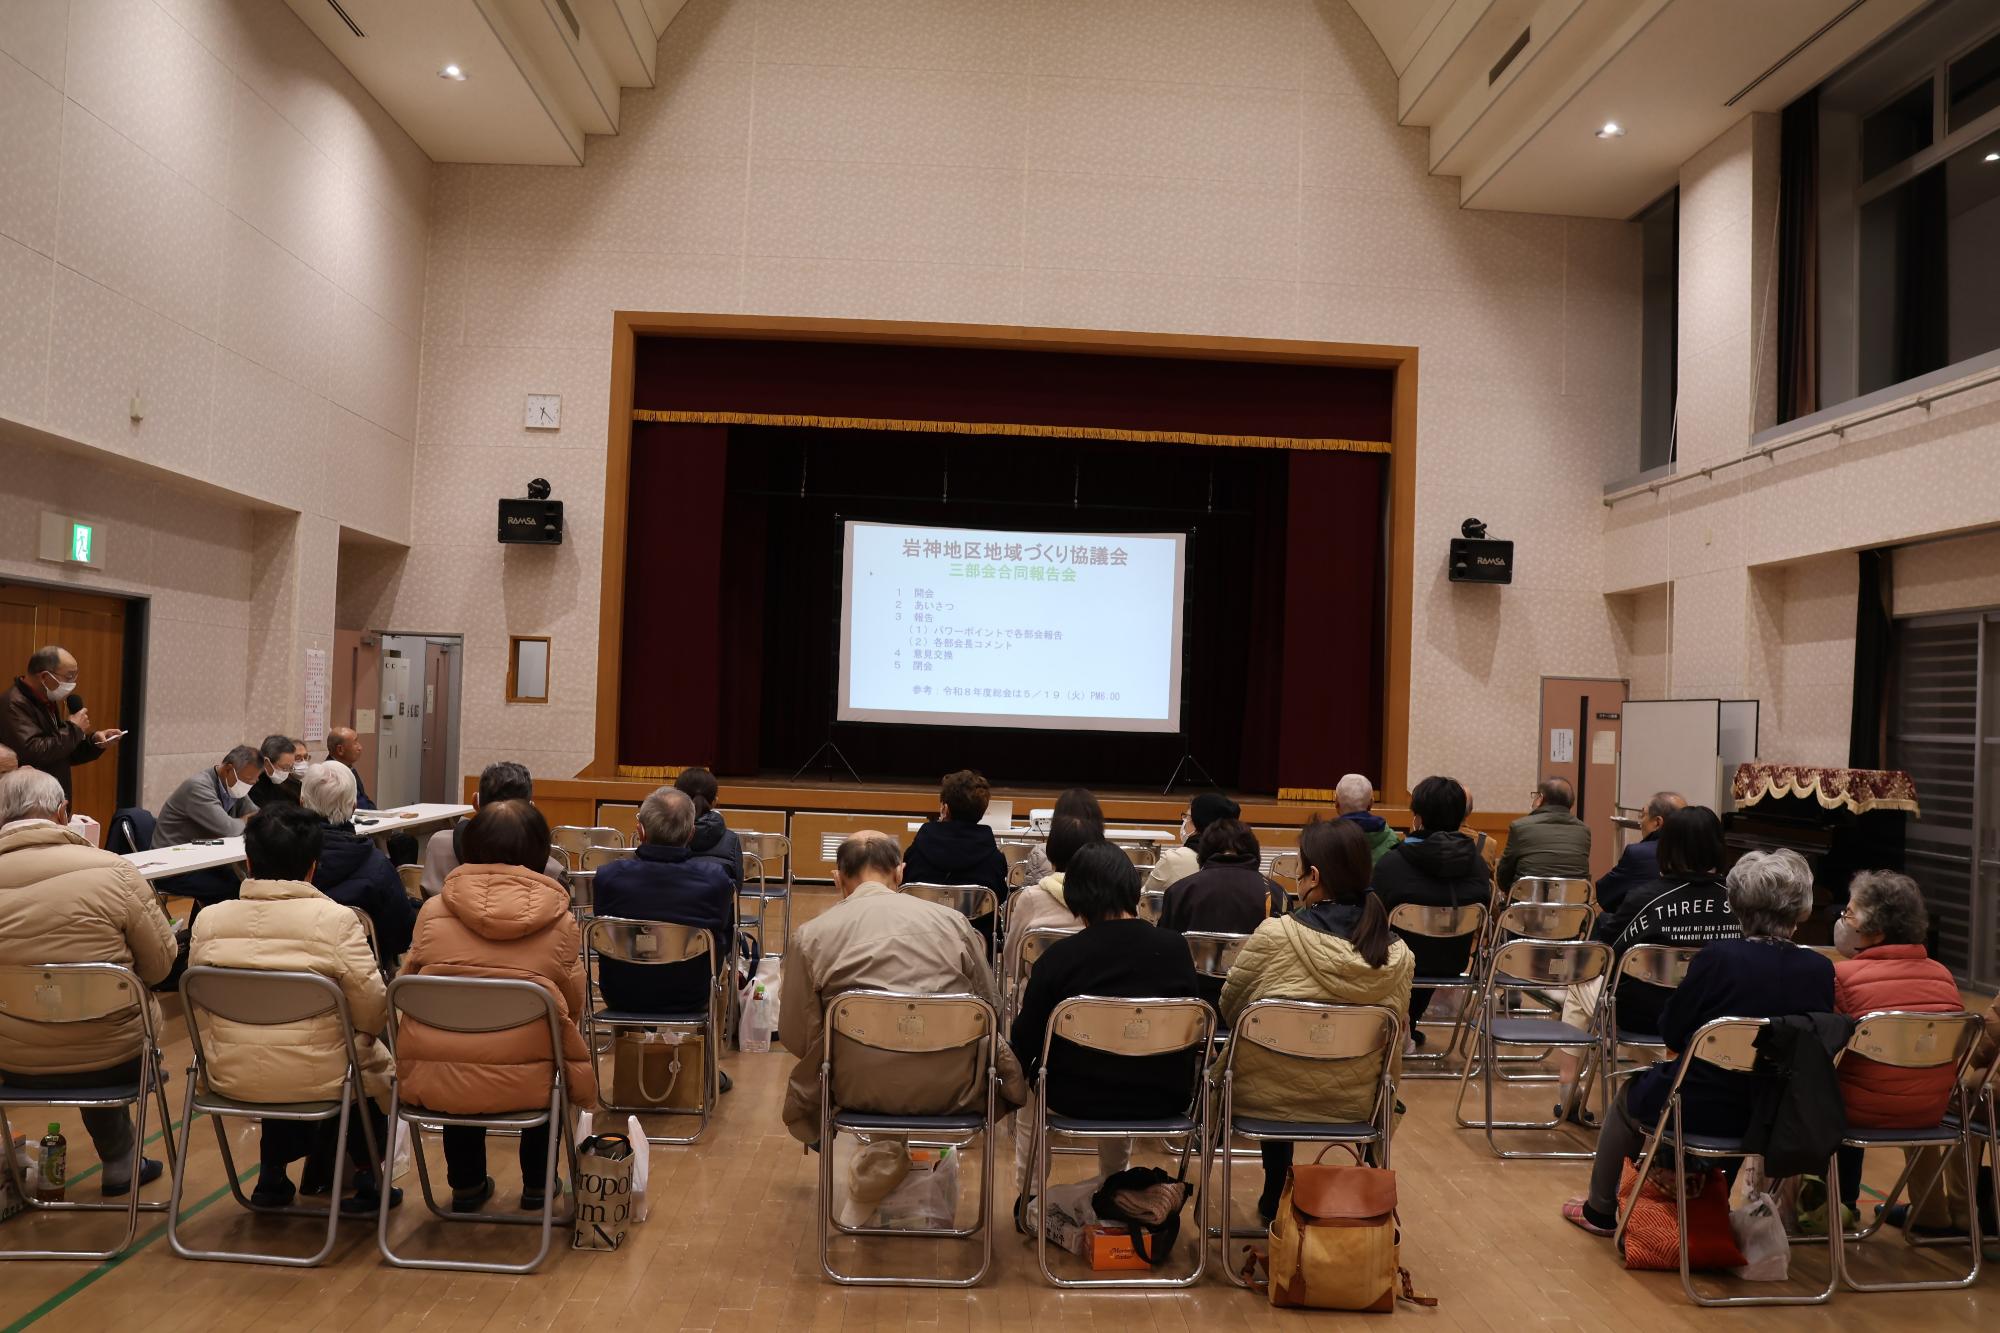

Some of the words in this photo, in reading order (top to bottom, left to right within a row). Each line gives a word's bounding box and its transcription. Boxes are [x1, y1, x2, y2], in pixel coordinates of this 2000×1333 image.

[507, 516, 537, 526] RAMSA
[902, 538, 1129, 566] 岩神地区地域づくり協議会
[1477, 556, 1506, 566] RAMSA
[949, 562, 1077, 582] 三部会合同報告会
[914, 588, 934, 599] 開会
[914, 600, 955, 612] あいさつ
[914, 612, 934, 623] 報告
[913, 649, 954, 661] 意見交換
[1655, 899, 1715, 920] THREE
